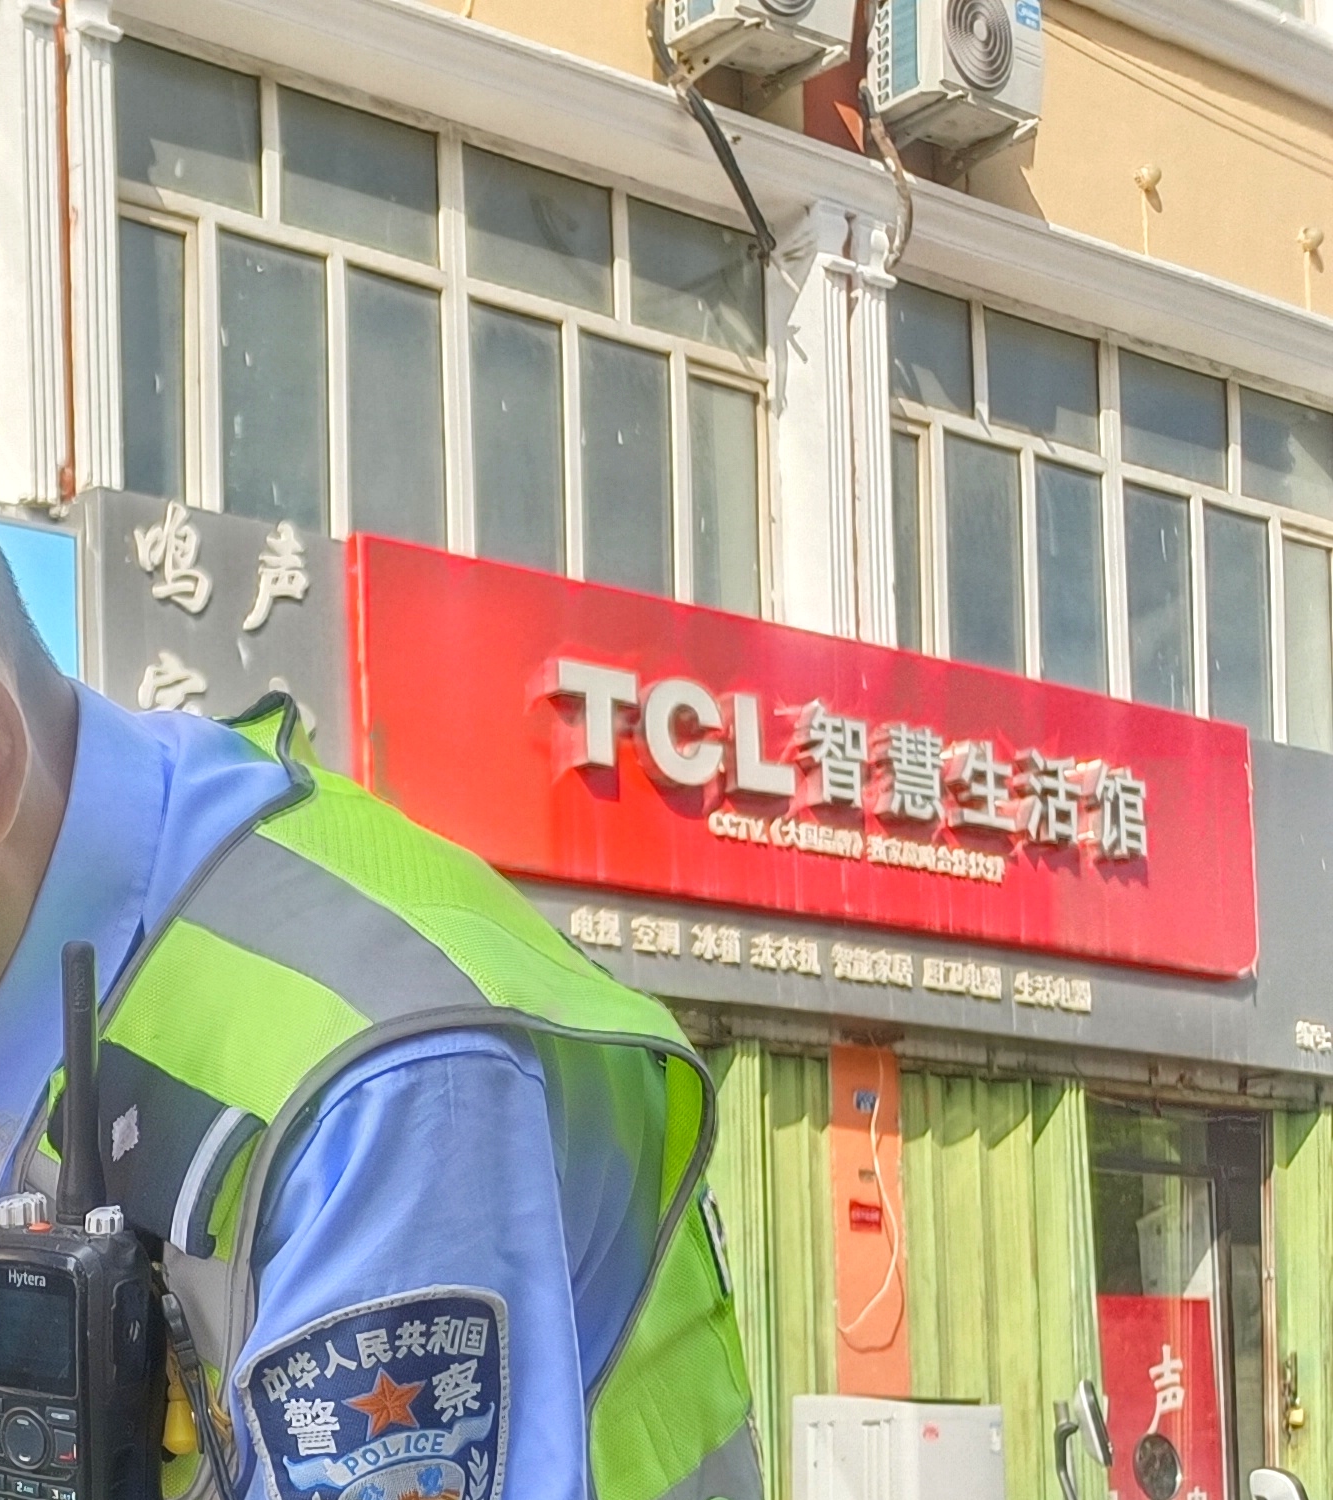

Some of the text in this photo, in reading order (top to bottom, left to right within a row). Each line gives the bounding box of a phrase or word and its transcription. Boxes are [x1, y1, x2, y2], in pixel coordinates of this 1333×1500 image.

[555, 657, 1149, 860] TCL 智慧生活馆
[570, 905, 622, 948] 电视
[630, 915, 681, 956] 空调
[690, 922, 742, 965] 冰箱
[749, 931, 822, 976] 洗衣机
[831, 941, 914, 988] 智能家居
[1013, 969, 1093, 1013] 生活电器
[8, 1268, 47, 1288] Hytera
[260, 1314, 490, 1403] 中华人民共和国
[342, 1432, 447, 1477] POLICE
